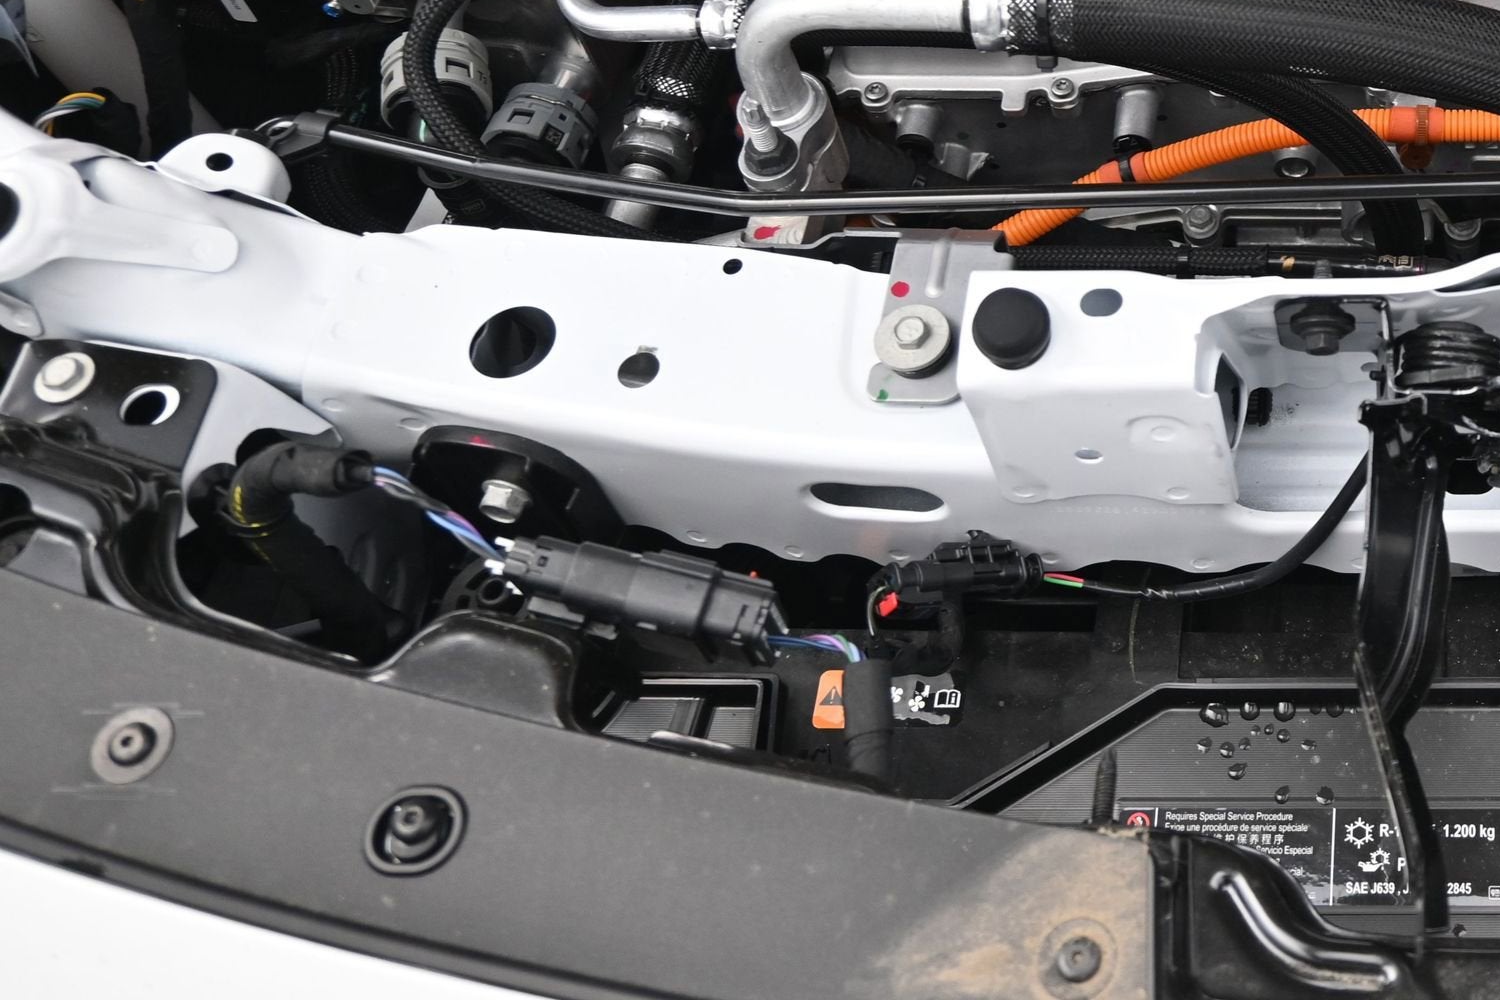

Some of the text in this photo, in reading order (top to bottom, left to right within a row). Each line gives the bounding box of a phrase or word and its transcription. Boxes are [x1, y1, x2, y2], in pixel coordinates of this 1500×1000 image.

[1165, 811, 1293, 821] Requires Special Service Procedure
[1202, 823, 1239, 833] procédure
[1239, 823, 1249, 832] de
[1250, 824, 1277, 832] service
[1278, 823, 1309, 833] spéciale
[1443, 824, 1476, 838] 1.200
[1480, 824, 1496, 842] kg
[1256, 845, 1313, 855] Servicio Especial
[1346, 882, 1368, 894] SAE
[1370, 882, 1395, 894] J639
